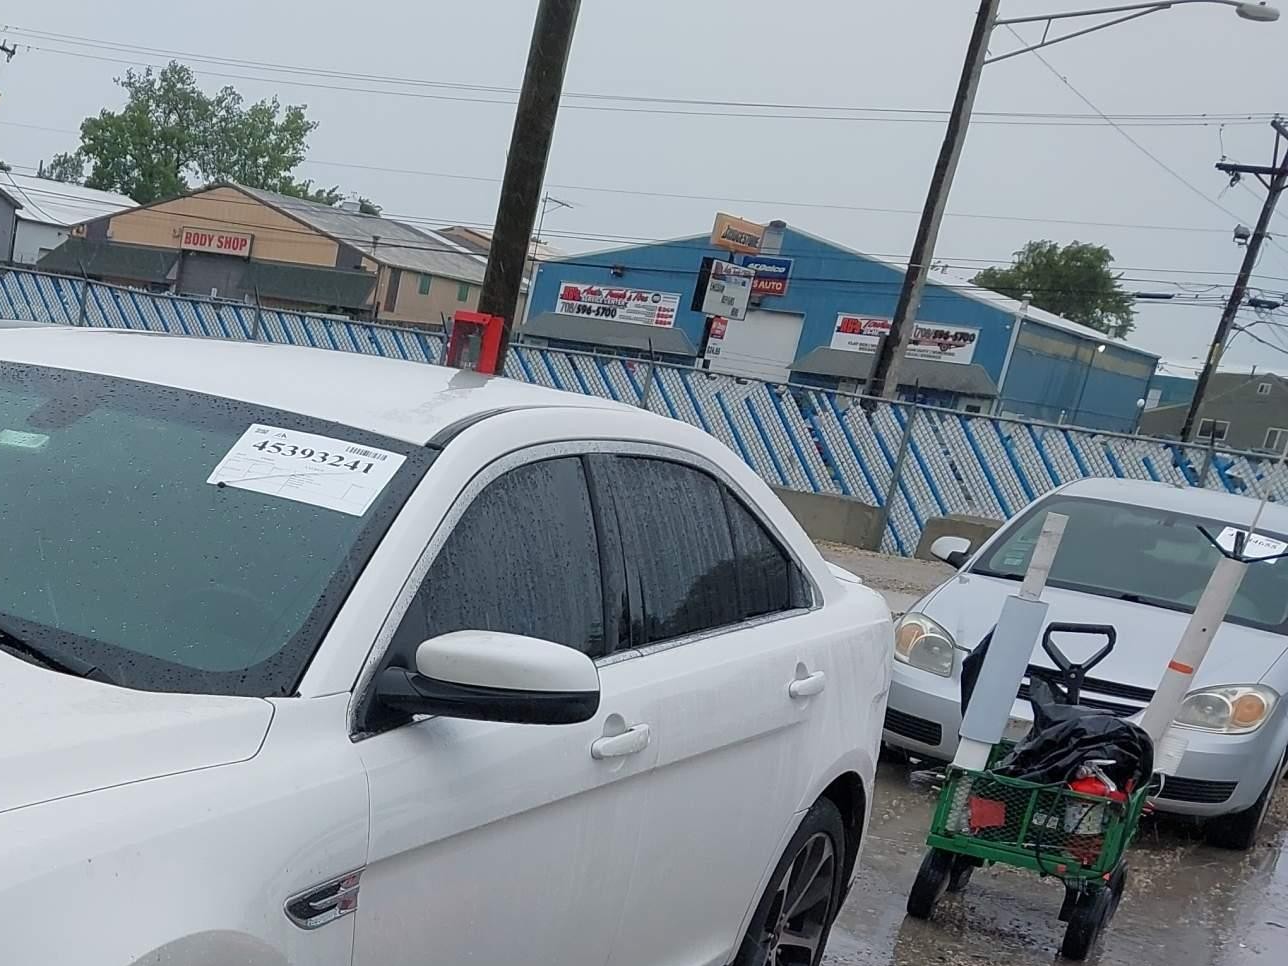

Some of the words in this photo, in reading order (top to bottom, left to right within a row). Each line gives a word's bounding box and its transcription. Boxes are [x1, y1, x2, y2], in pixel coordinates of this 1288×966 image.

[184, 231, 215, 247] BODY
[216, 235, 248, 251] SHOP
[758, 279, 783, 291] AUTO
[560, 302, 617, 319] 708/596-5700
[252, 439, 374, 474] 45393241
